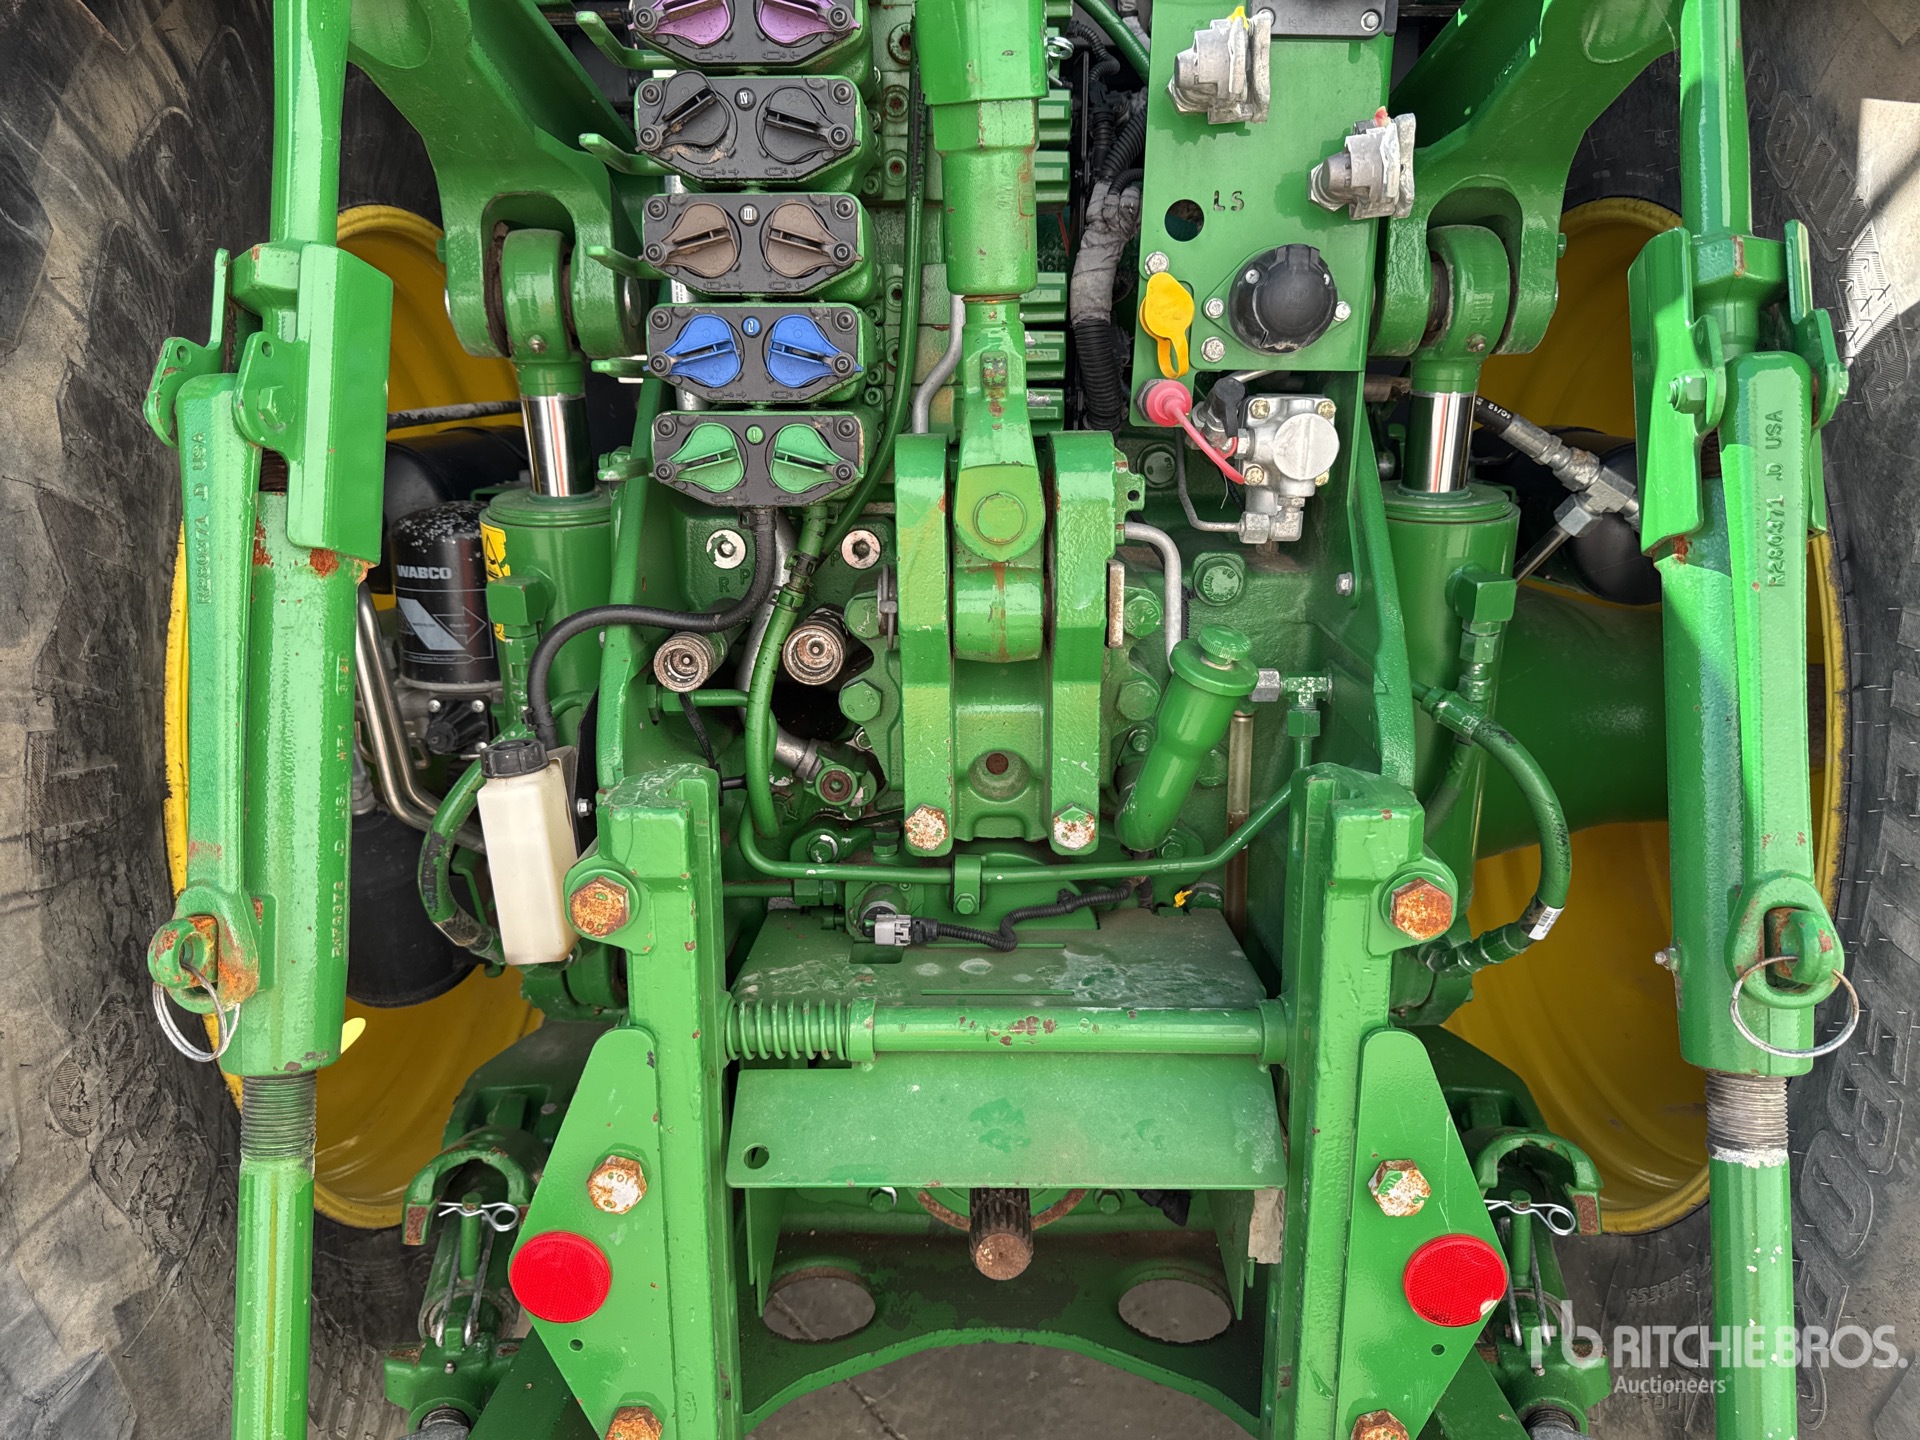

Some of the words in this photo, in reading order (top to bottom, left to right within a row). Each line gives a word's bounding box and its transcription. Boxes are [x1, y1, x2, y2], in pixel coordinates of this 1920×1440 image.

[1213, 189, 1245, 212] LS
[743, 207, 753, 220] III
[1765, 409, 1784, 450] USA
[191, 432, 208, 471] USA
[1764, 495, 1786, 588] R280371
[396, 564, 452, 580] WABCO
[718, 577, 730, 593] R
